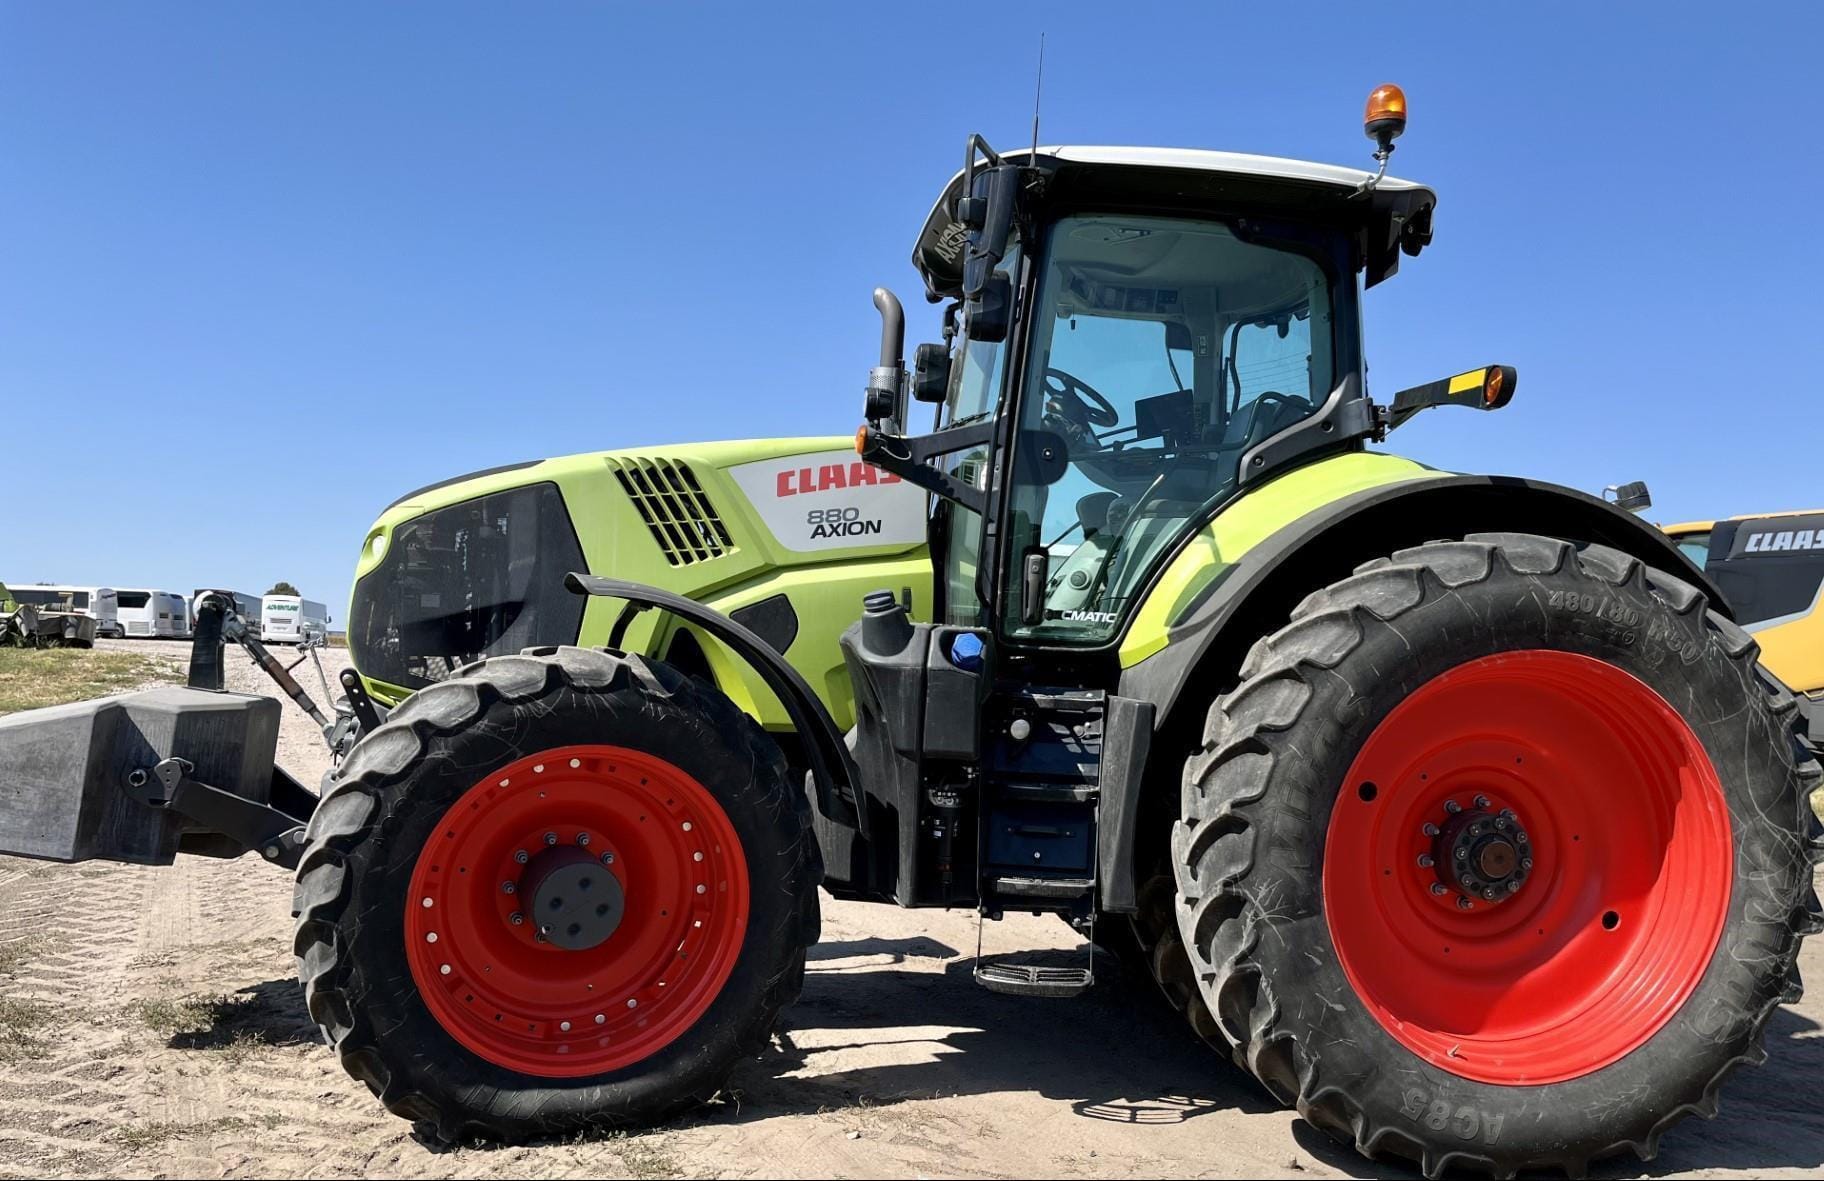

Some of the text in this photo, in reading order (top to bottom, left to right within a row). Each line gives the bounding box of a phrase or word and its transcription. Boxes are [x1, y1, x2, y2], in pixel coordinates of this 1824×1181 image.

[807, 507, 859, 524] 880
[810, 520, 881, 539] AXION
[1061, 610, 1117, 623] CMATIC
[1400, 1087, 1504, 1145] AC85
